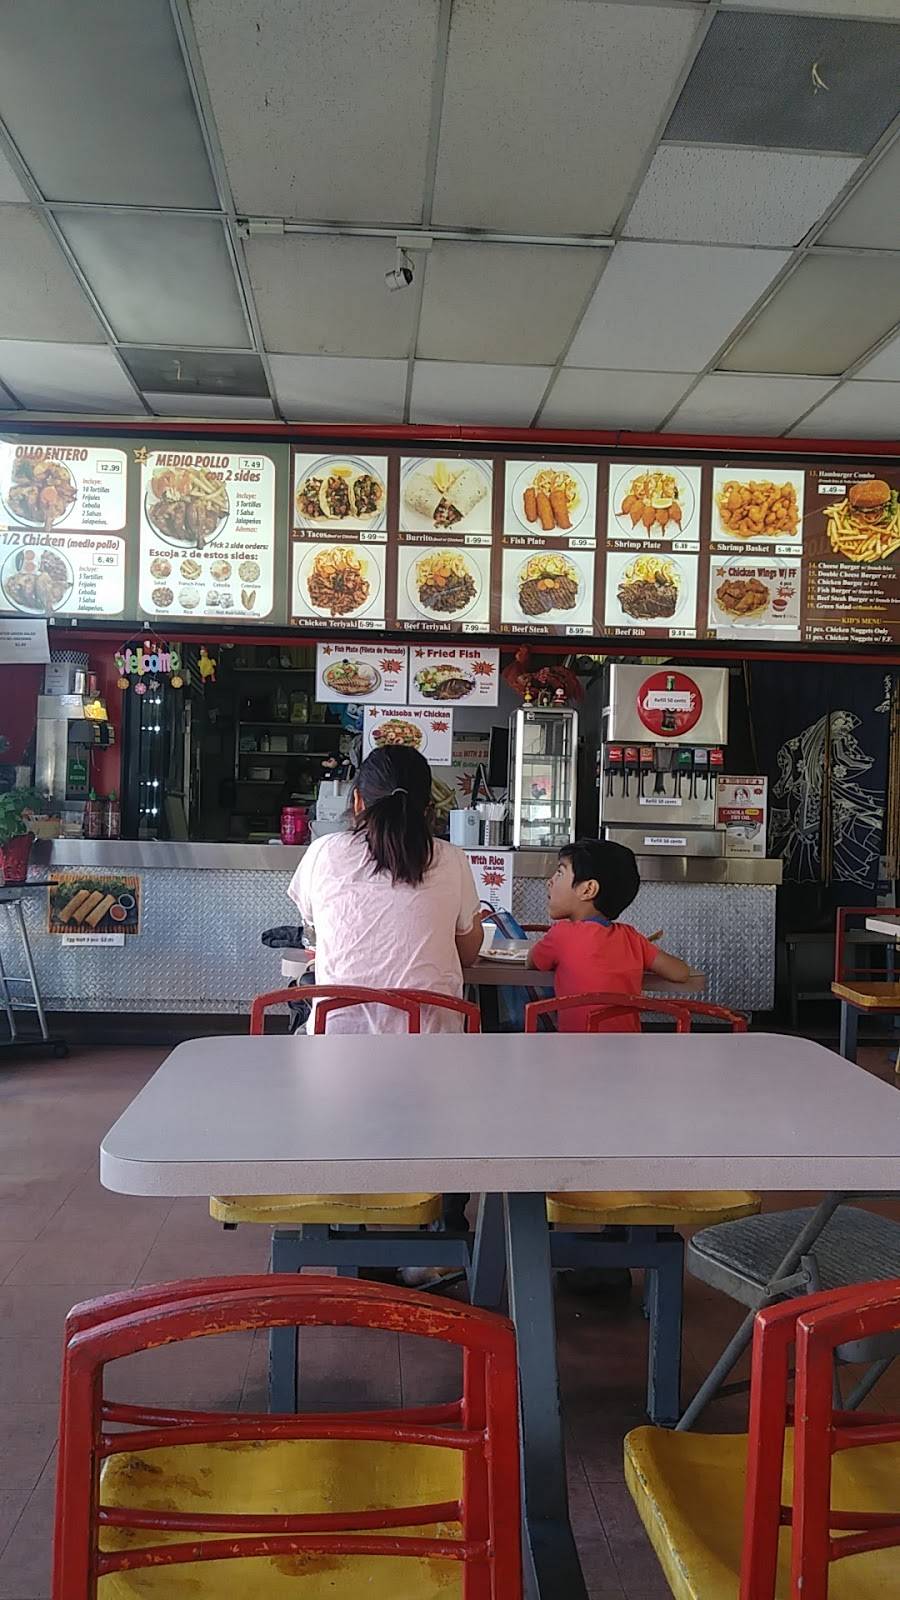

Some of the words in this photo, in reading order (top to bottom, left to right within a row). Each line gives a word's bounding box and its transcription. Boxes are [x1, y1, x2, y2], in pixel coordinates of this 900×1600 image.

[11, 446, 47, 459] OLLO
[46, 447, 88, 461] ENTERO
[156, 454, 193, 467] MEDIO
[195, 456, 229, 469] POLLO
[101, 464, 120, 472] 12.99
[206, 472, 223, 481] con
[226, 472, 232, 481] 2
[234, 471, 260, 482] sides
[3, 533, 20, 546] 1/2
[22, 533, 65, 547] Chicken
[67, 538, 95, 549] (medio
[96, 540, 120, 551] pollo)
[527, 537, 546, 545] Plate
[615, 541, 641, 549] Shrimp
[643, 541, 662, 549] Plate
[717, 544, 744, 553] Shrimp
[149, 549, 179, 559] Escoja
[231, 552, 258, 560] sides:
[728, 568, 755, 577] Chicken
[757, 568, 776, 579] Wings
[789, 569, 797, 577] FF
[299, 619, 327, 627] Chicken
[329, 620, 357, 628] Teriyaki
[404, 622, 420, 630] Beef
[421, 623, 451, 632] Teriyaki
[427, 650, 455, 658] Fried
[459, 650, 480, 658] Fish
[114, 647, 181, 677] Welcome
[380, 709, 412, 717] Yakisoba
[471, 855, 487, 864] With
[489, 855, 505, 865] Rice
